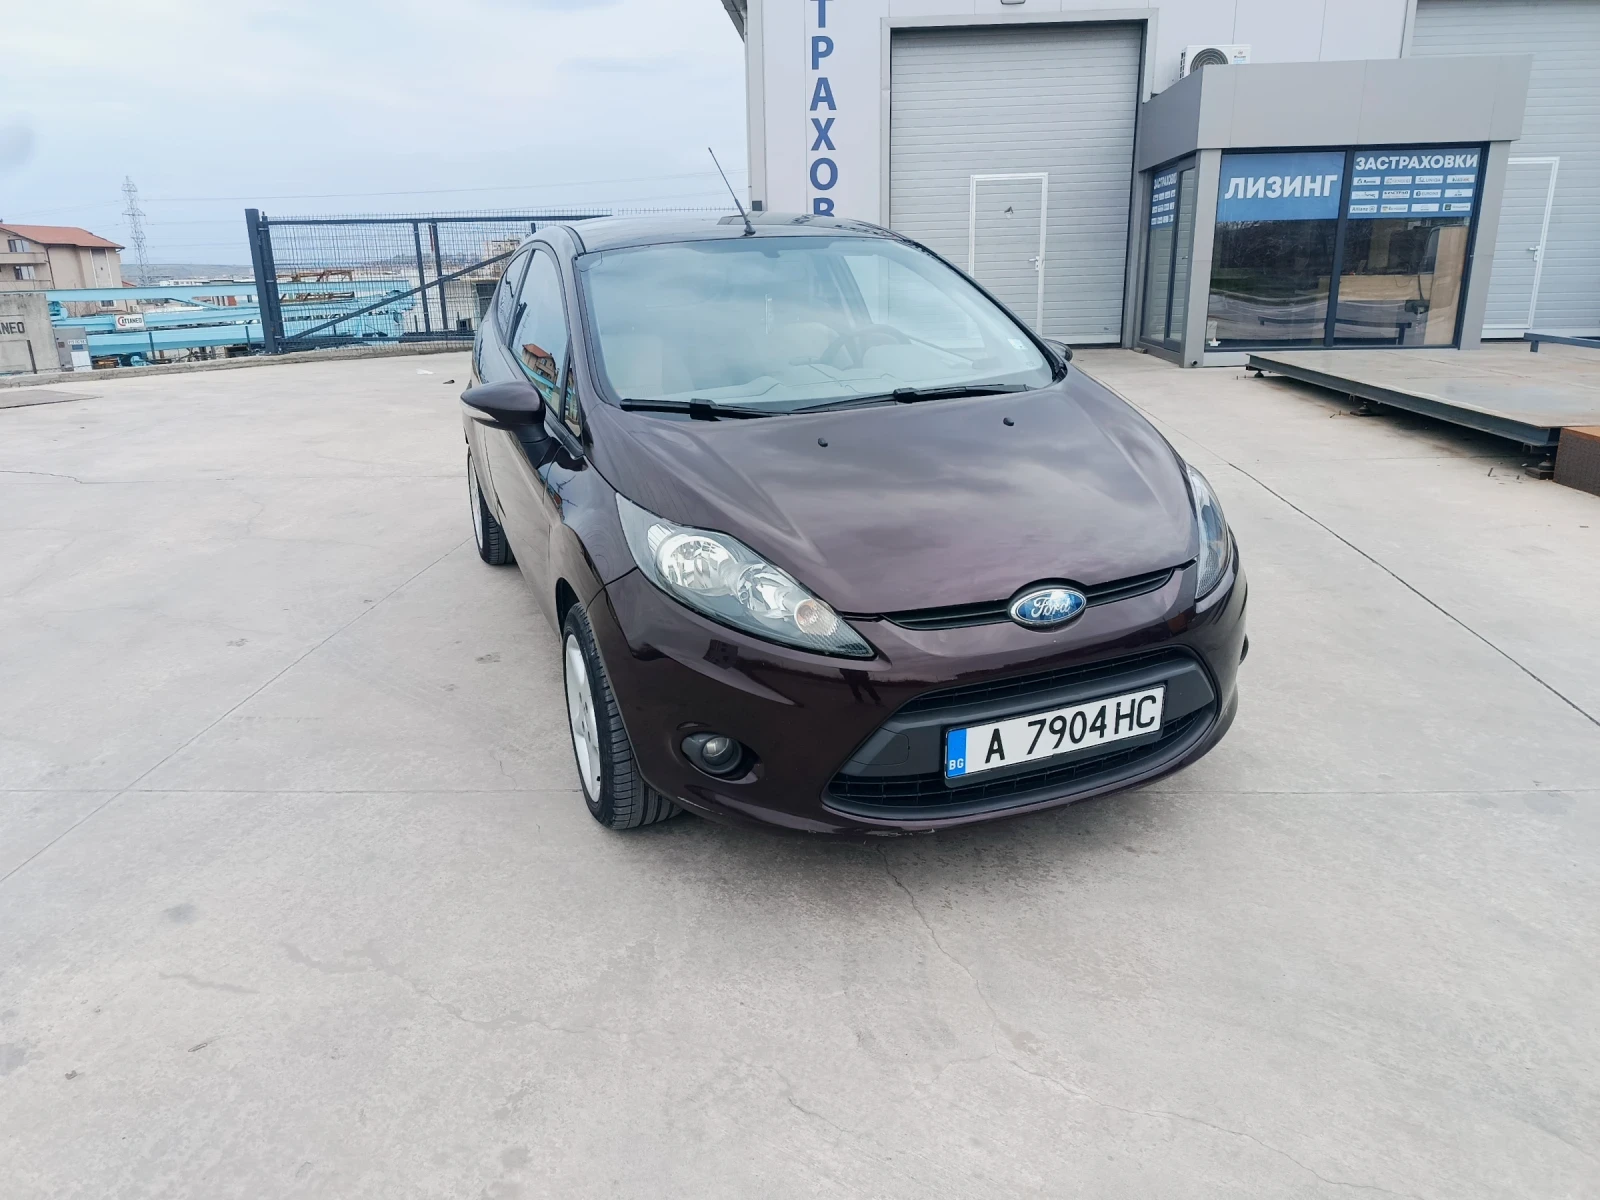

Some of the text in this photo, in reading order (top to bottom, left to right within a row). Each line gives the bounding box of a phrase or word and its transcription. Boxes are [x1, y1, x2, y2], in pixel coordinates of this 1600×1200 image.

[1355, 154, 1478, 170] ЗАСТРАХОВКИ
[1225, 174, 1338, 199] ЛИЗИНГ
[0, 321, 25, 335] NEO
[1031, 597, 1071, 618] Ford
[985, 728, 1006, 764] A
[949, 758, 965, 771] BG
